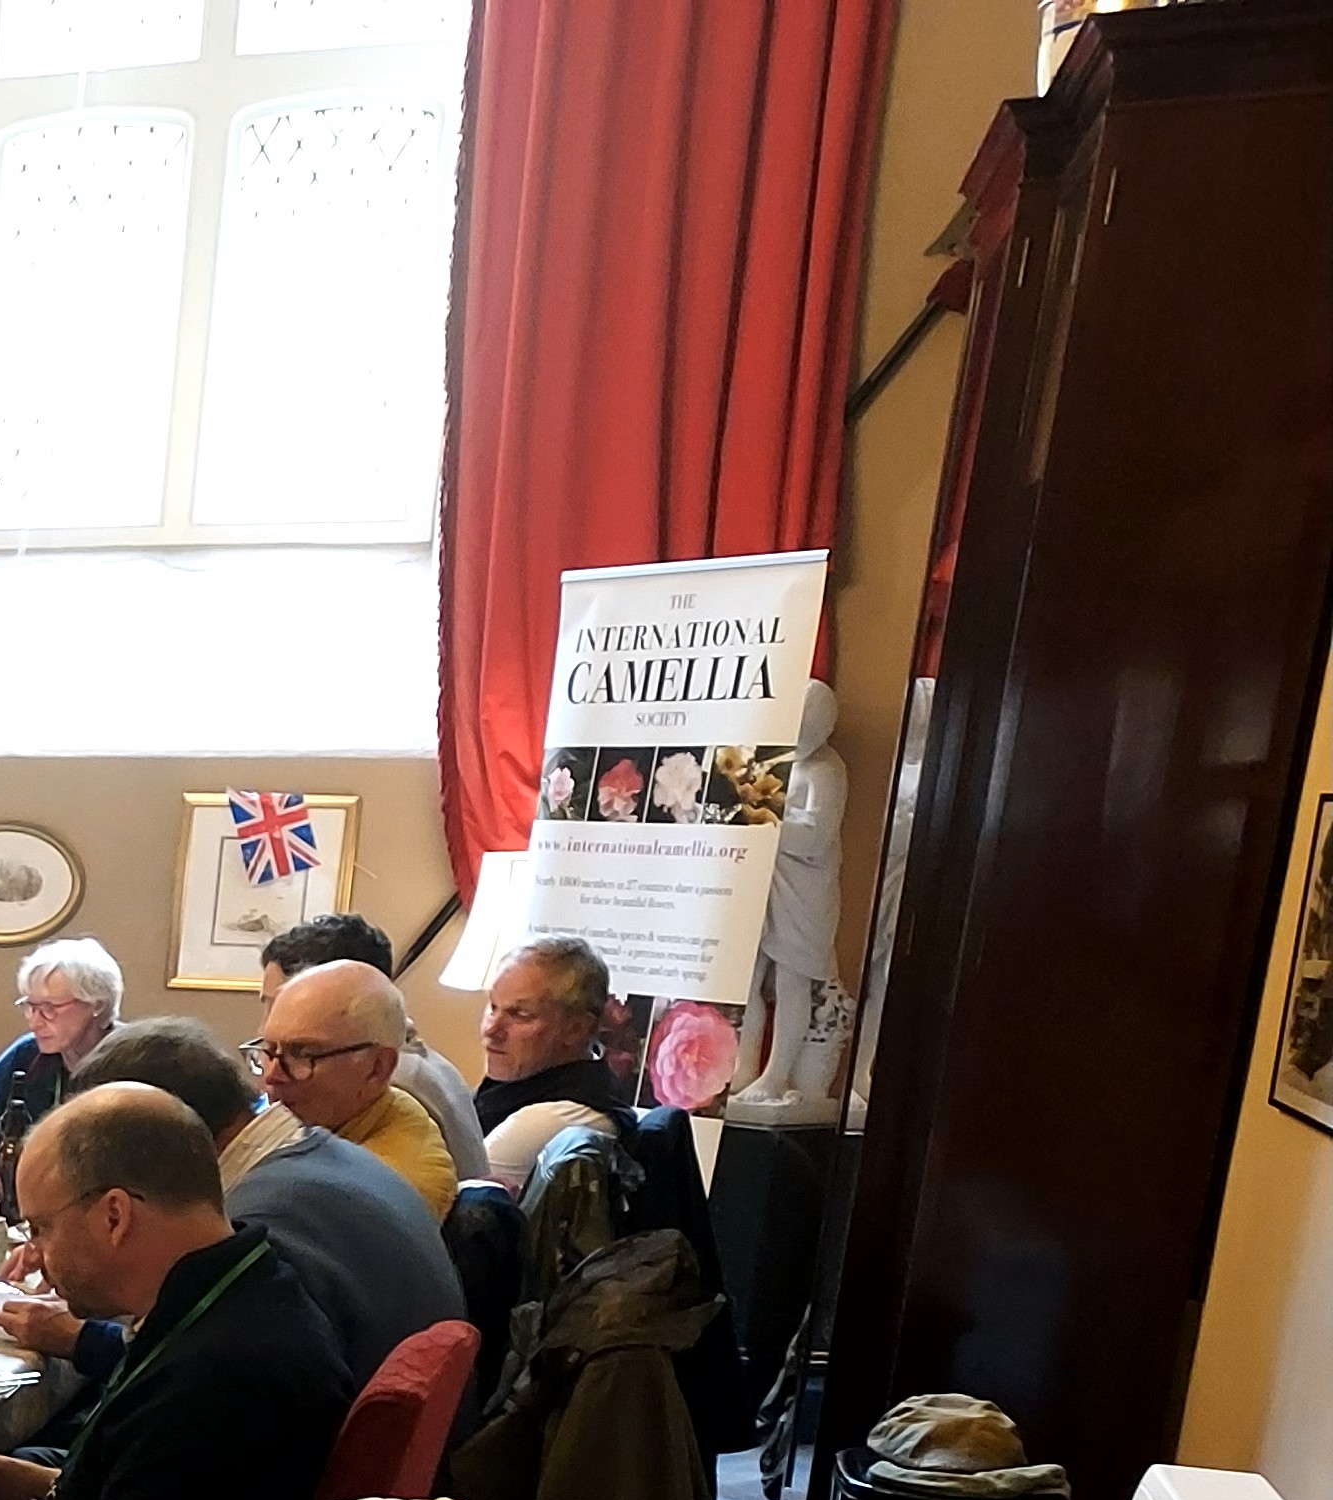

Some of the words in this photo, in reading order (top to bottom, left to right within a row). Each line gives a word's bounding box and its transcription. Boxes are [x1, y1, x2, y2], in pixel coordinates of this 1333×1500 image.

[670, 593, 697, 610] THE
[576, 616, 785, 653] INTERNATIONAL
[567, 654, 776, 704] CAMELLIA
[634, 711, 689, 727] SOCIETY
[537, 836, 749, 863] www.internationalcamellia.org
